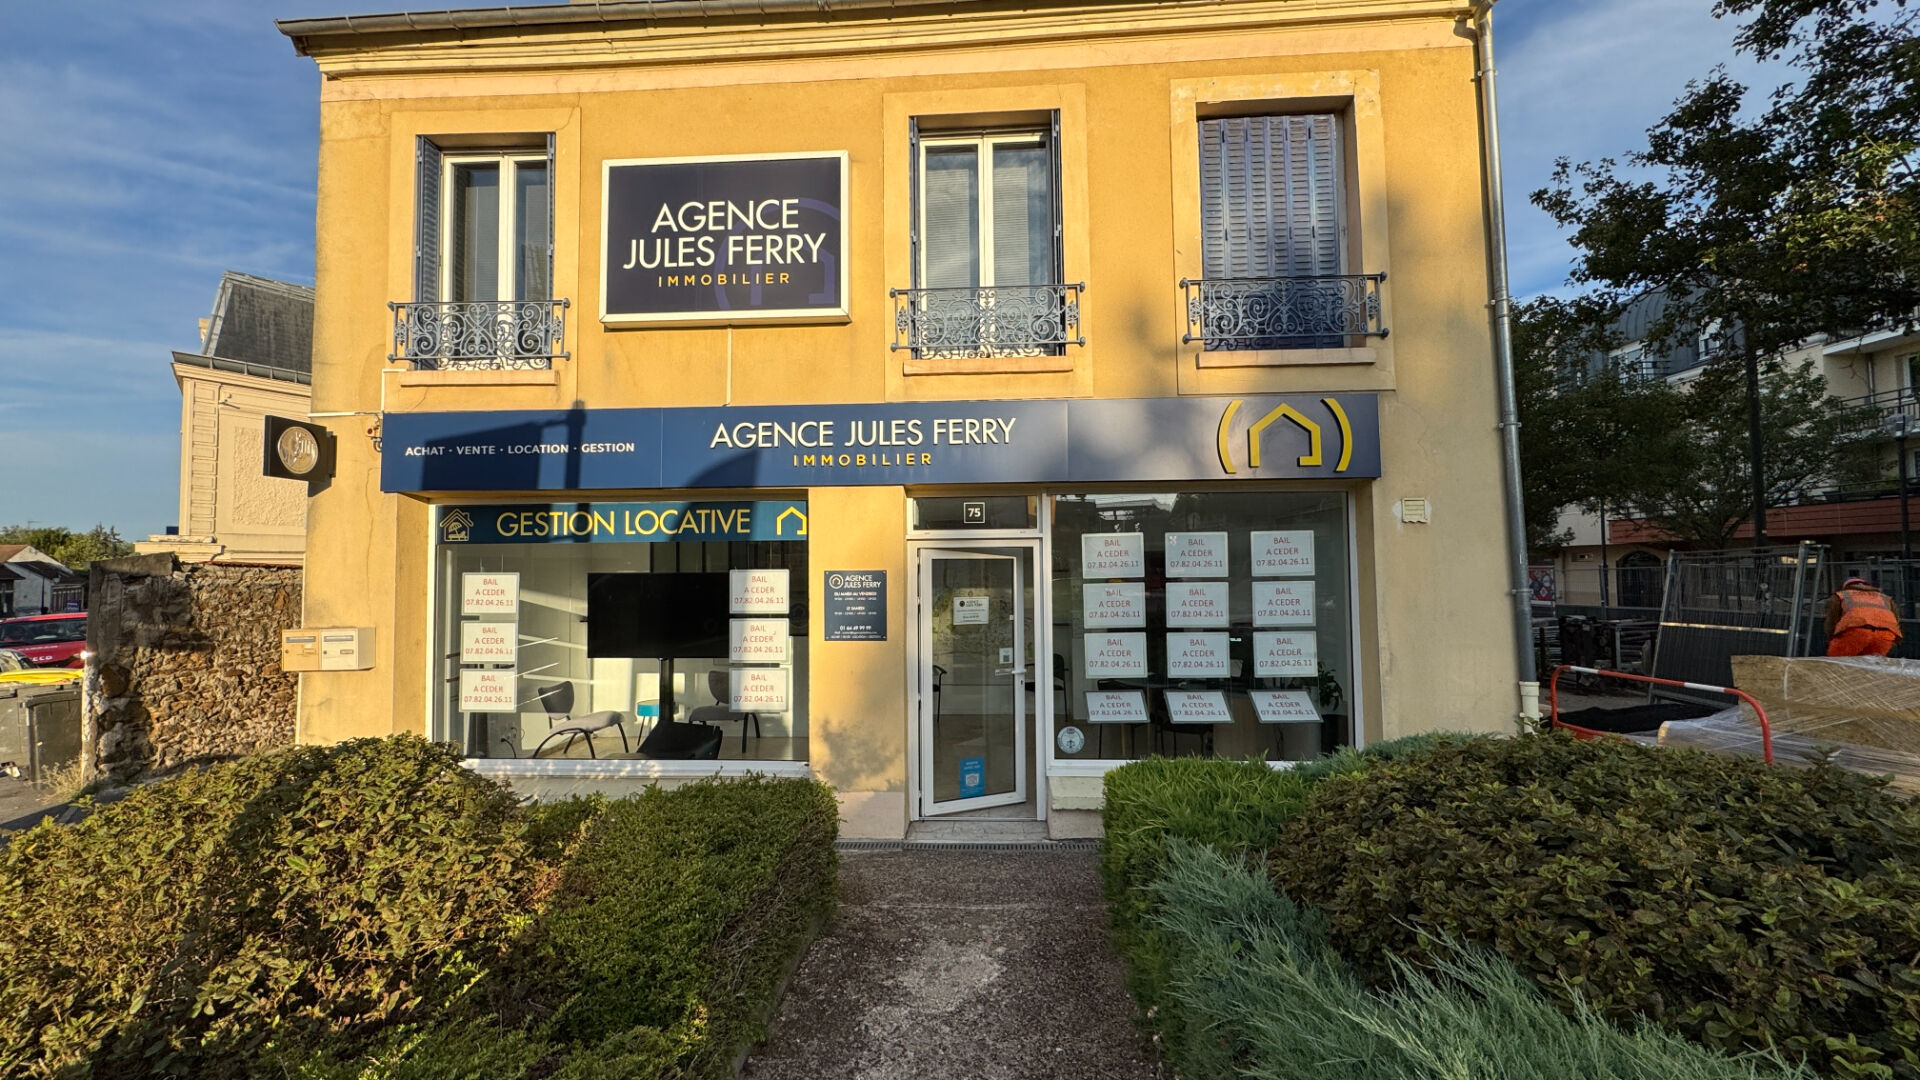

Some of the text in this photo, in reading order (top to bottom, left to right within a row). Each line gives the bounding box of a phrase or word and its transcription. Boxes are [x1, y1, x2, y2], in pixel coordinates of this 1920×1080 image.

[651, 198, 800, 233] AGENCE
[622, 232, 826, 270] JULES FERRY
[658, 272, 790, 288] IMMOBILIER
[710, 417, 1016, 449] AGENCE JULES FERRY
[405, 442, 635, 456] ACHAT VENTE LOCATION GESTION
[793, 453, 932, 467] IMMOBILIER
[496, 508, 750, 537] GESTION LOCATIVE
[967, 508, 980, 518] 75
